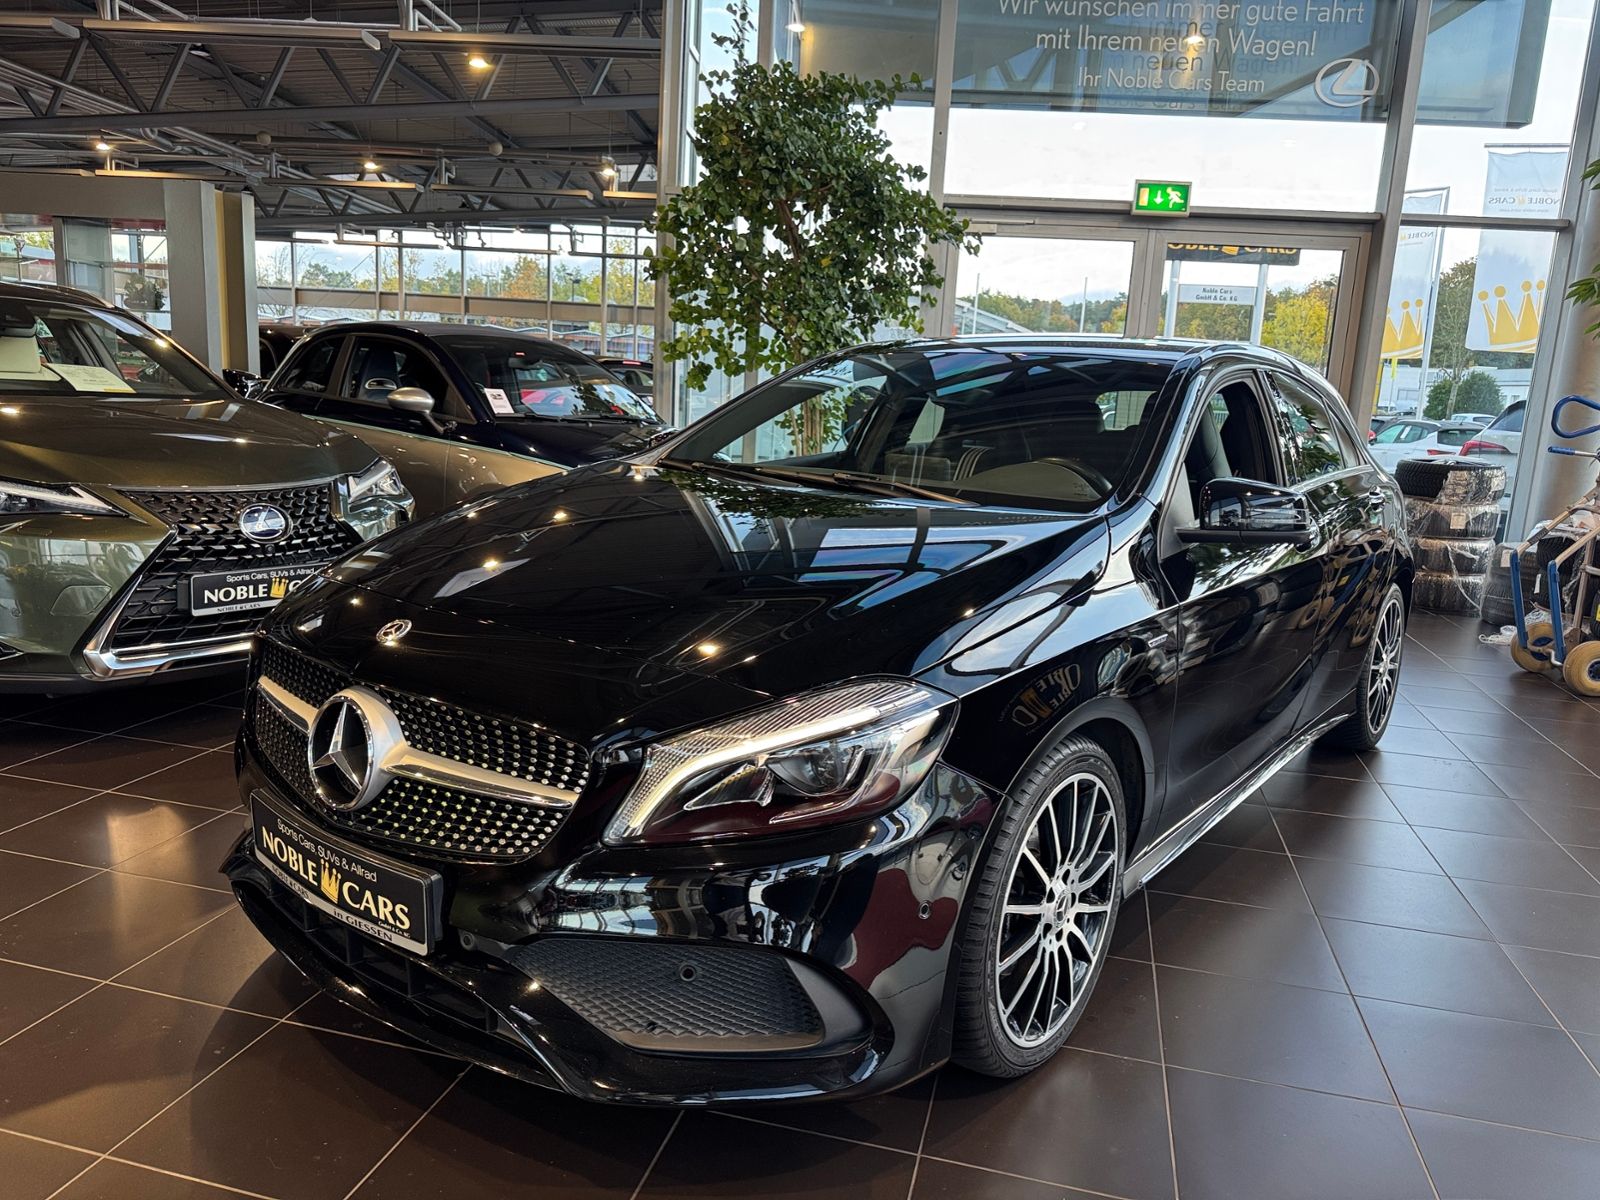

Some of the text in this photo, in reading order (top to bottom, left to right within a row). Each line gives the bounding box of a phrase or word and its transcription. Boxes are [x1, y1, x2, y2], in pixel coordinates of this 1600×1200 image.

[999, 0, 1040, 15] Wir
[1246, 2, 1298, 27] gute
[1305, 0, 1365, 24] Fahrt
[1035, 24, 1318, 61] mit Ihrem neuen Wagen!
[1077, 67, 1265, 93] Ihr Noble Cars Team
[226, 574, 250, 584] Sports
[269, 570, 289, 579] SUVs
[289, 569, 295, 577] &
[204, 584, 268, 603] NOBLE
[277, 818, 299, 844] Sports
[317, 844, 341, 867] SUVs
[341, 857, 350, 871] &
[350, 861, 378, 884] Allrad
[261, 825, 411, 931] NOBLE CARS
[333, 908, 394, 942] in GIESSEN
